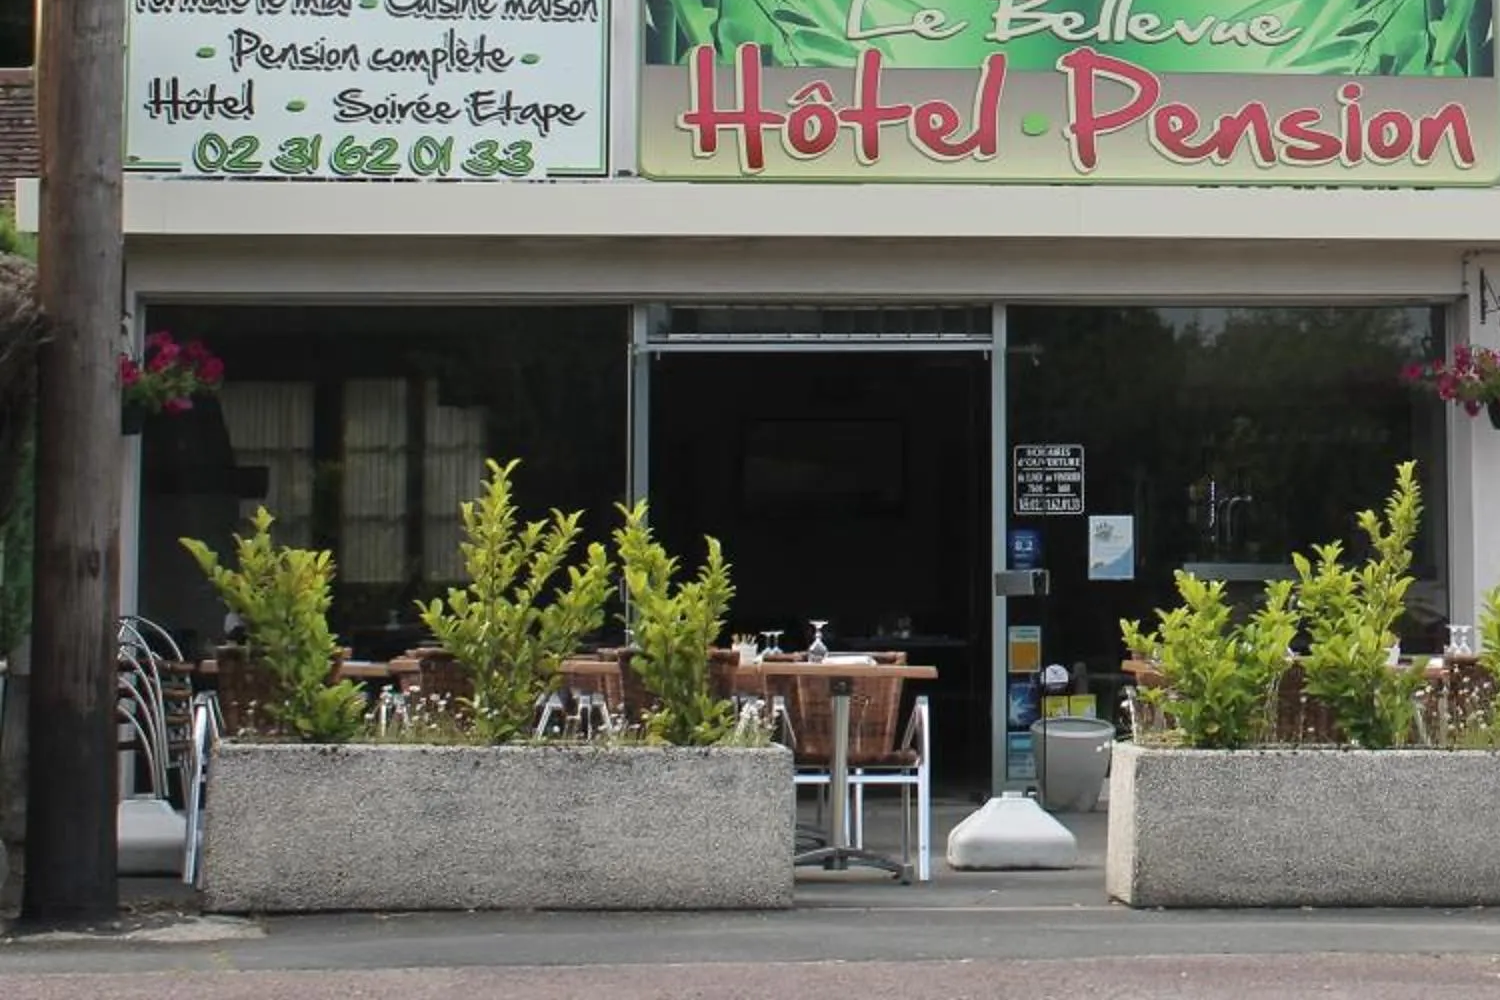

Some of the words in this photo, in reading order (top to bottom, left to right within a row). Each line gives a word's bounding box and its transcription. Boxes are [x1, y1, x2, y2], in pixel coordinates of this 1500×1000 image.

[228, 28, 361, 72] Pension
[367, 28, 515, 84] complète
[145, 78, 256, 123] Hôtel
[333, 88, 462, 124] Soirée
[464, 90, 587, 136] Etape
[677, 41, 1007, 172] Hôtel
[1057, 45, 1476, 173] Pension
[193, 133, 263, 172] 02
[270, 134, 322, 172] 31
[330, 136, 401, 175] 62
[408, 136, 453, 176] 01
[464, 139, 535, 177] 33
